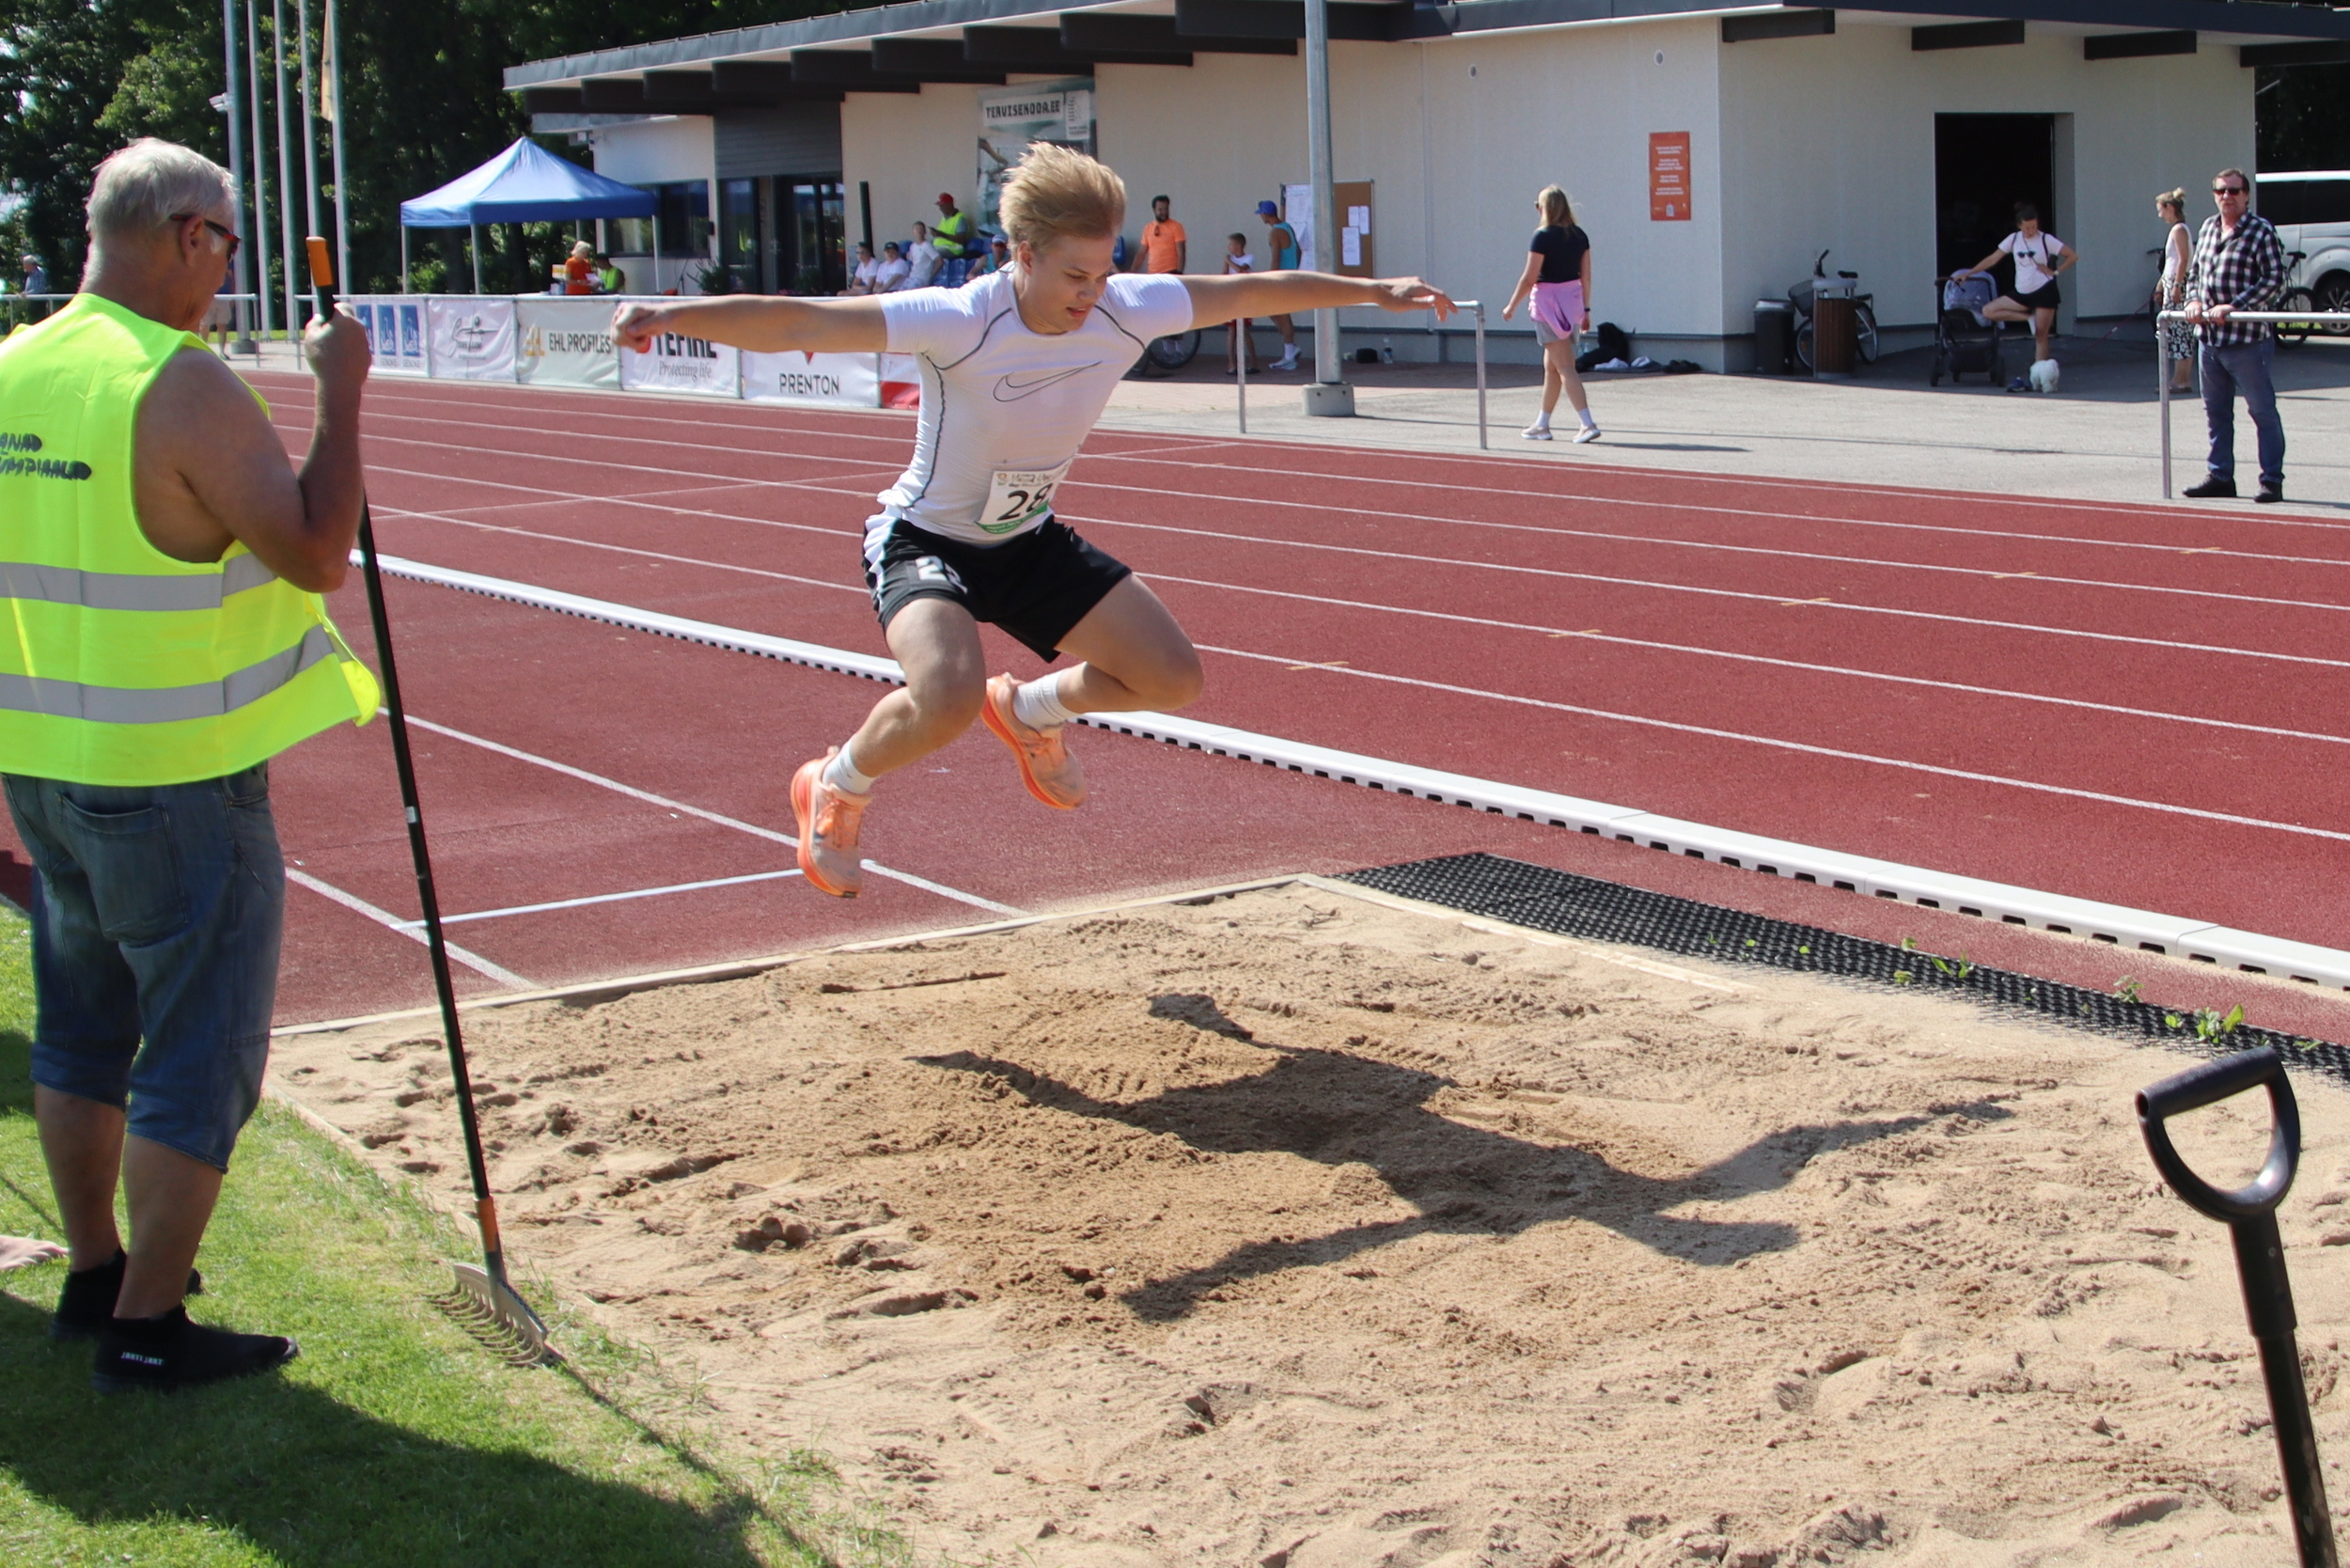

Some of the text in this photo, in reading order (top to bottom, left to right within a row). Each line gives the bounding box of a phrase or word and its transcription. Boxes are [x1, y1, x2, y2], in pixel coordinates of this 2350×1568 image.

[548, 332, 611, 354] EHL PROFILES
[659, 361, 712, 382] Protecting life
[779, 372, 839, 396] PRENTON
